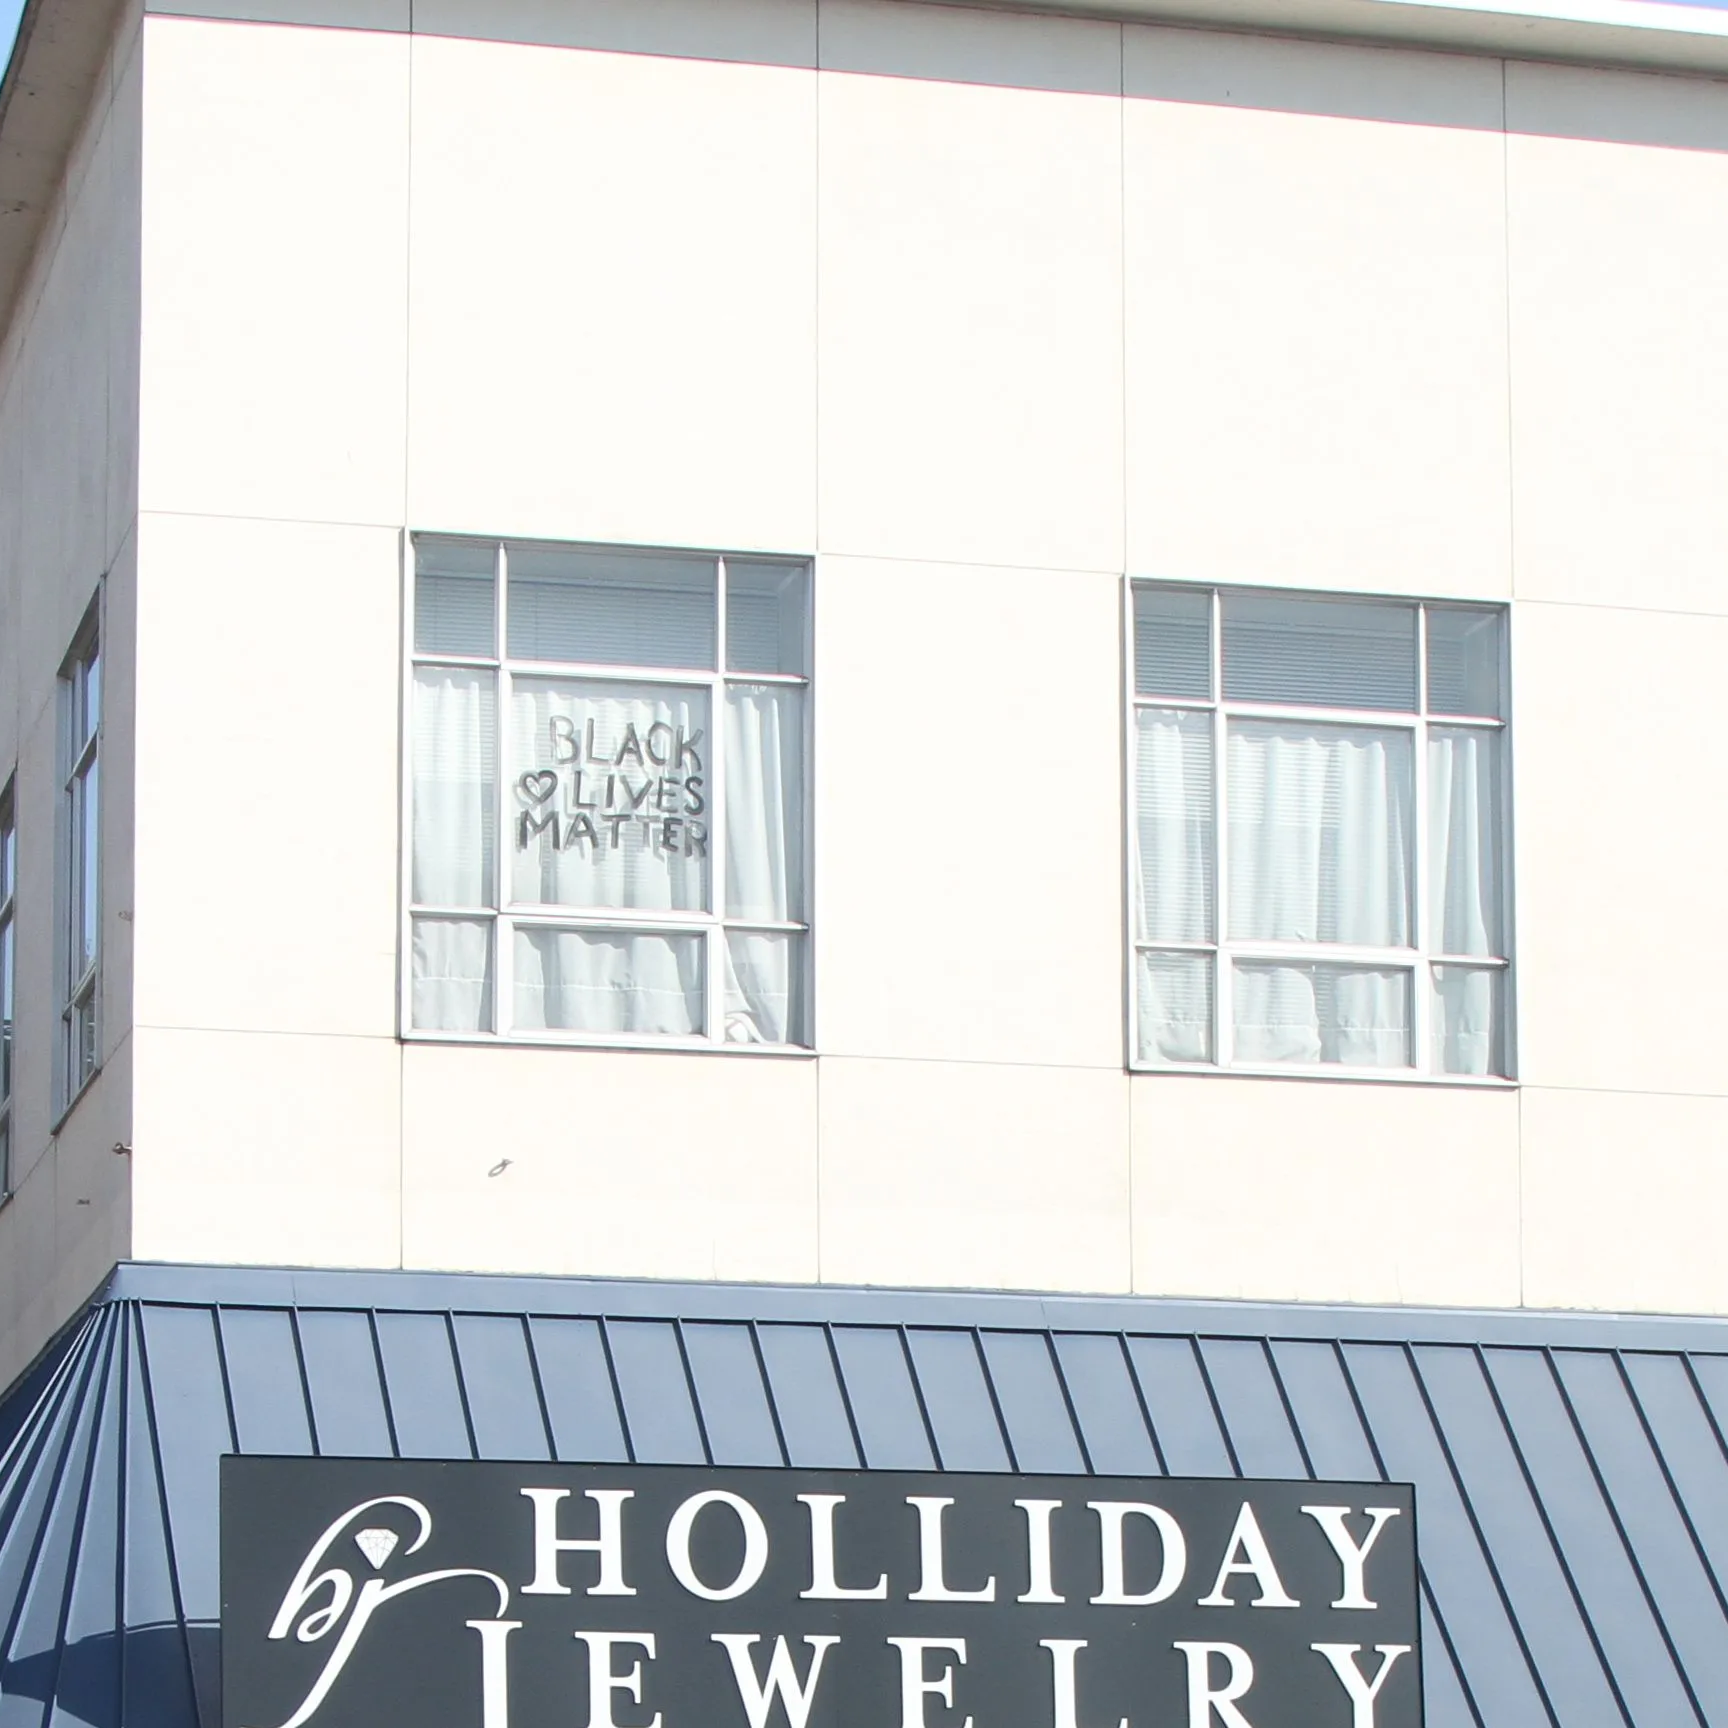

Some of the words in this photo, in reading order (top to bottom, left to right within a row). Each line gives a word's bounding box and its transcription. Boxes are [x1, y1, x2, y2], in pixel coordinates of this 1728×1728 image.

[549, 715, 704, 771] BLACK
[572, 769, 705, 815] LIVES
[518, 809, 708, 858] MATTER
[518, 1486, 1402, 1612] HOLLIDAY
